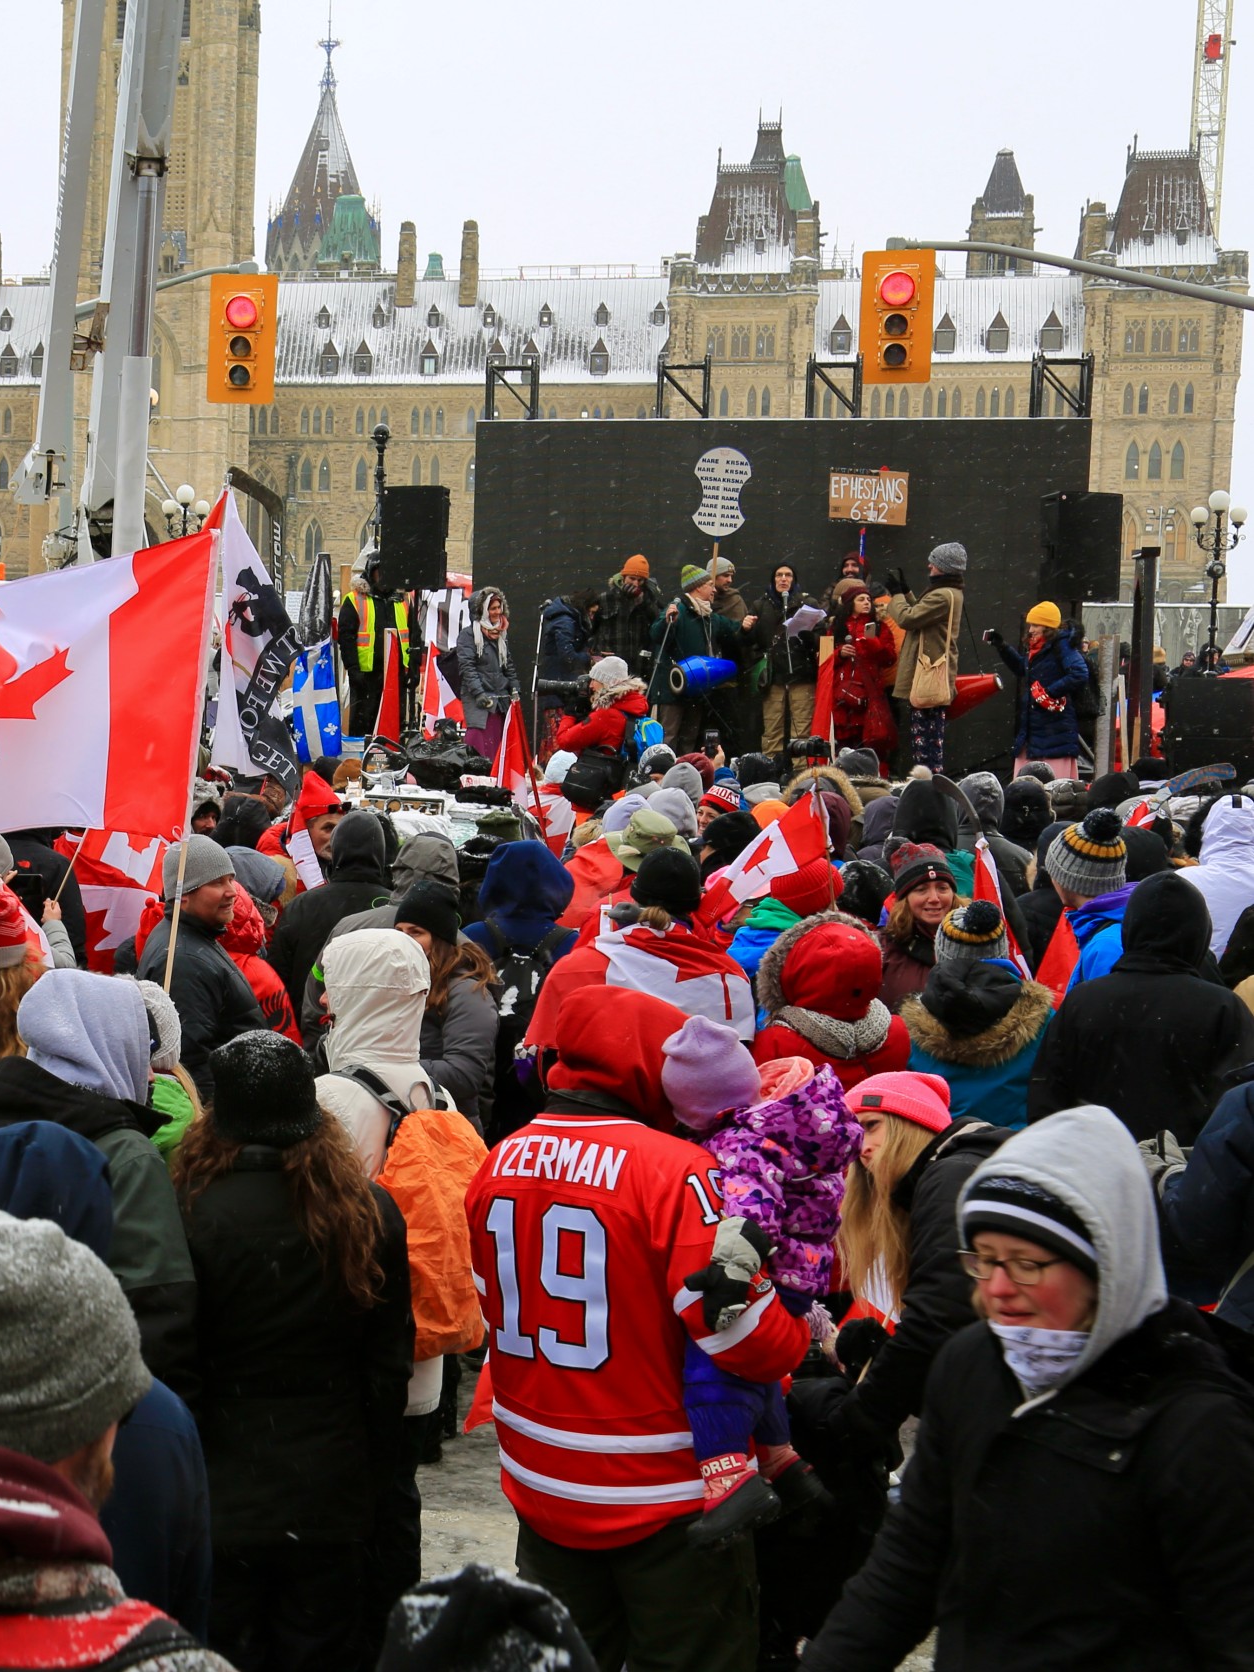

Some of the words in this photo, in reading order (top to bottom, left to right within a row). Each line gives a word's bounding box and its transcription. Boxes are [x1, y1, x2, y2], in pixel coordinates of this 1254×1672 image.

[831, 476, 907, 504] EPHESIANS
[850, 500, 888, 523] 6:12
[273, 521, 283, 600] arrow
[491, 1135, 627, 1191] YZERMAN
[485, 1197, 610, 1371] 19
[701, 1455, 742, 1477] OREL
